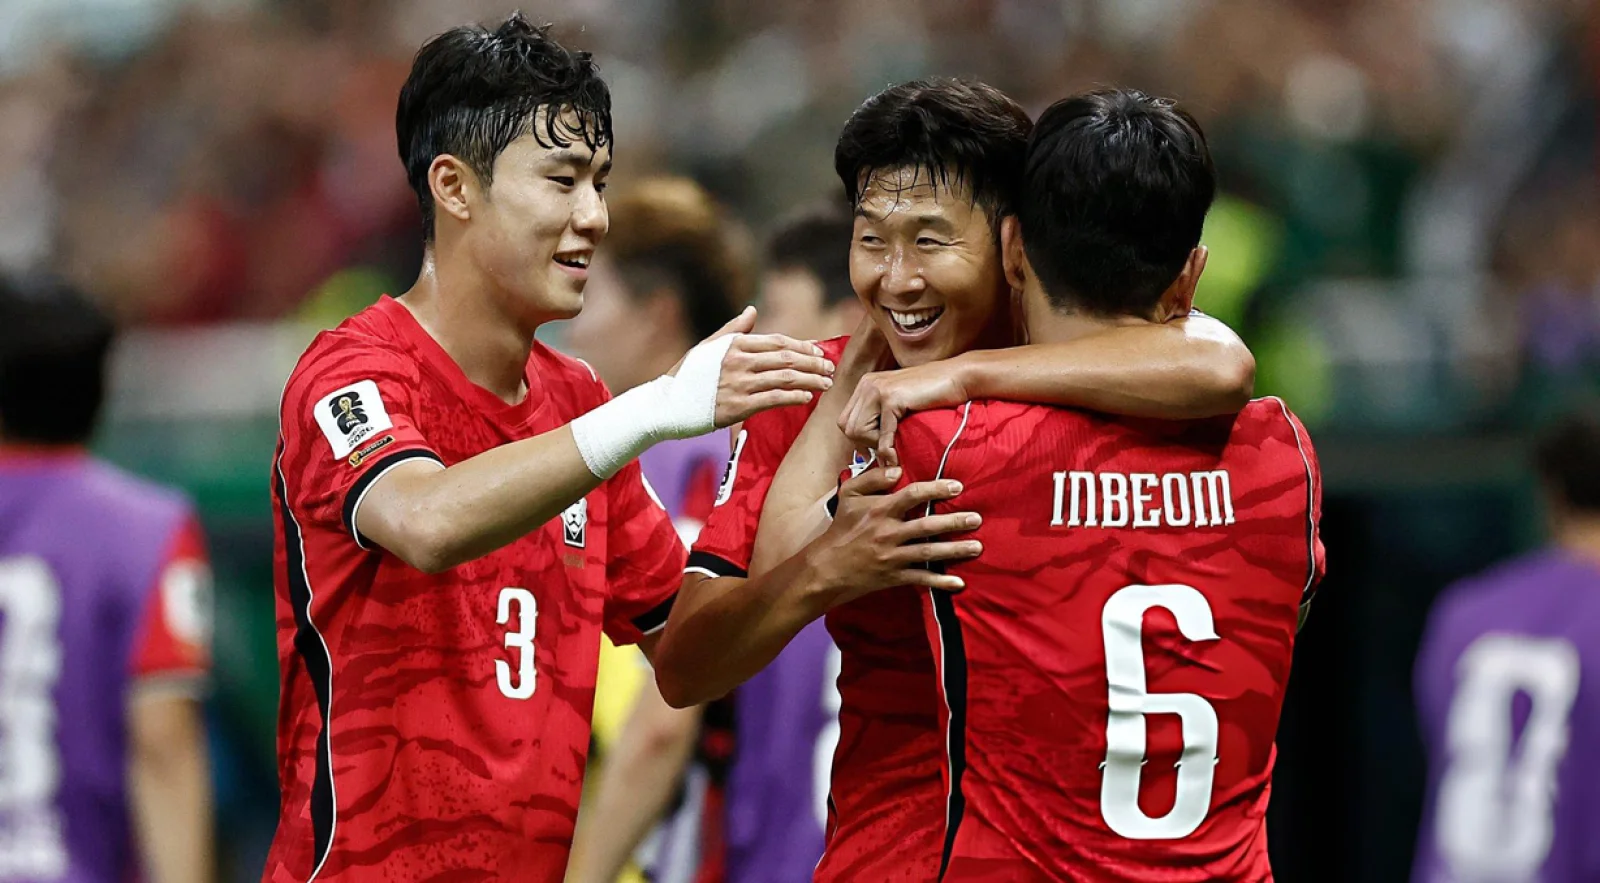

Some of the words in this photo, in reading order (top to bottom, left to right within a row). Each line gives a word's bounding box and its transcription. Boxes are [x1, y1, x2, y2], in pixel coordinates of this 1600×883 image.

[1050, 470, 1235, 528] INBEOM
[494, 586, 538, 700] 3
[1099, 584, 1221, 840] 6
